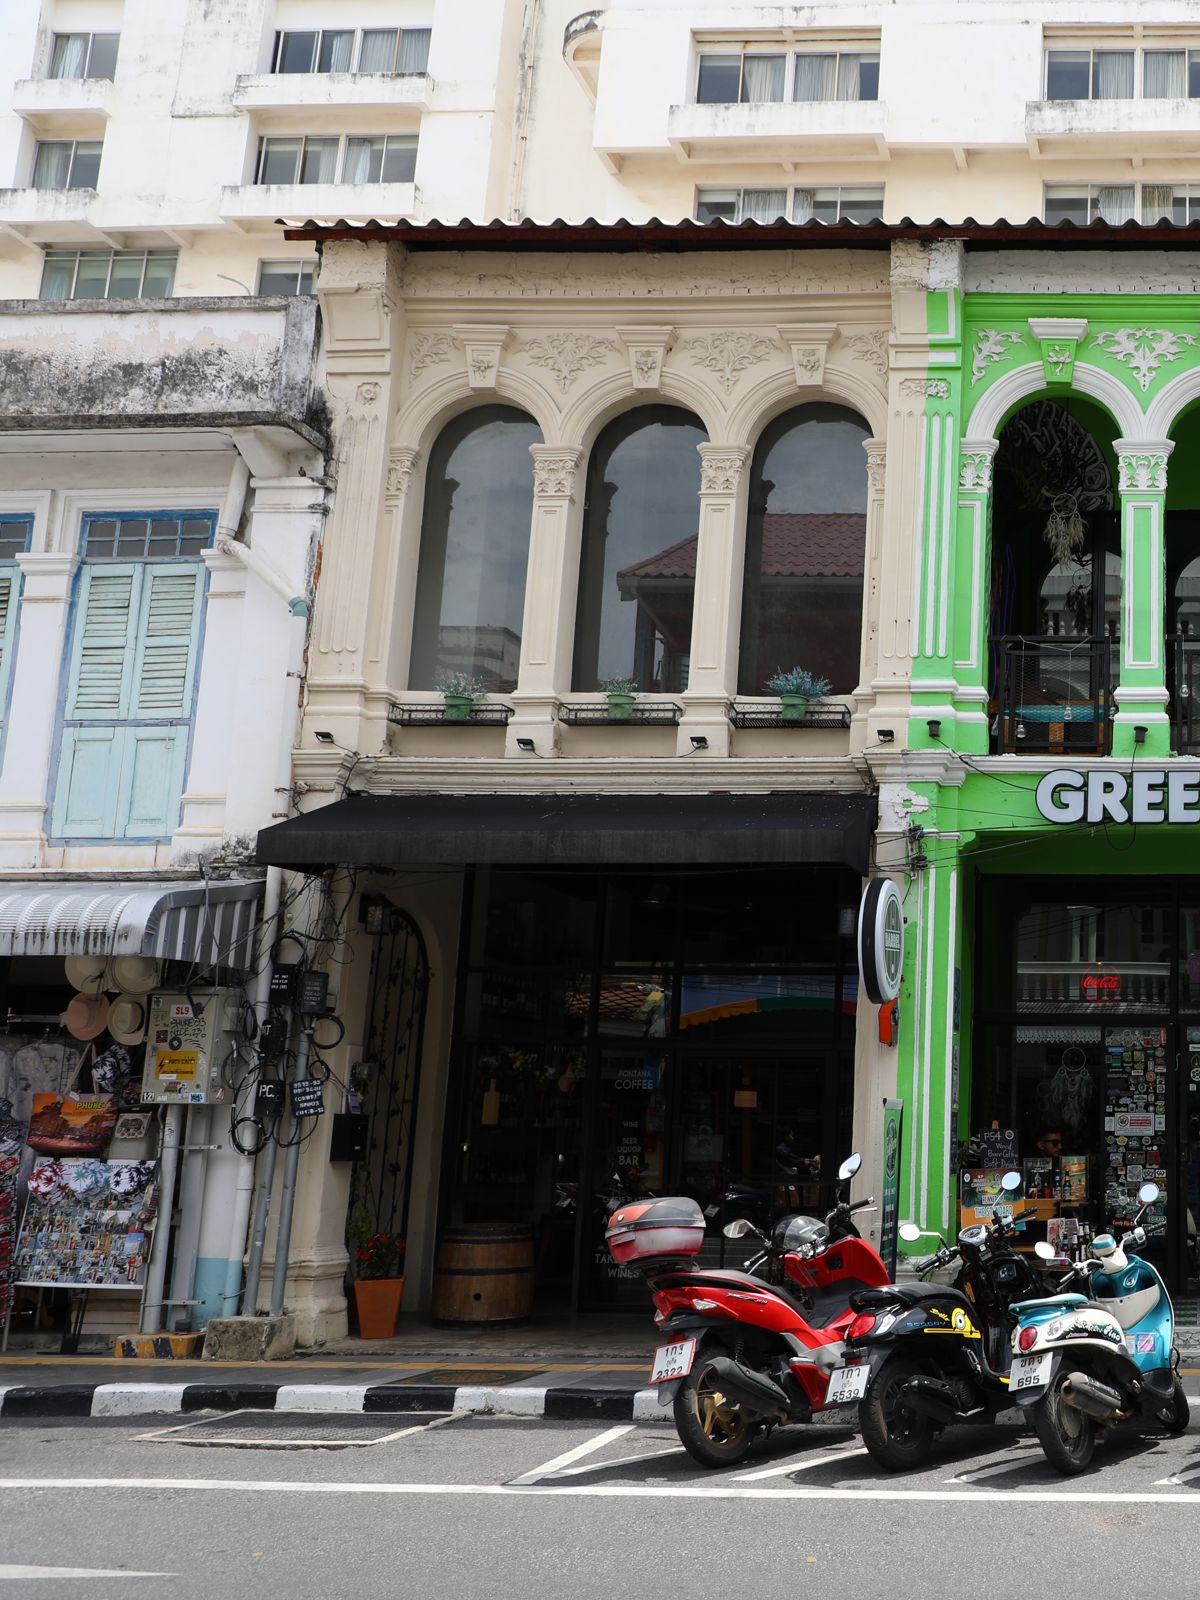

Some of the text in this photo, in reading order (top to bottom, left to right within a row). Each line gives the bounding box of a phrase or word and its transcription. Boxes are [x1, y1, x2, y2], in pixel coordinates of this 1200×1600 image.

[175, 1006, 190, 1015] SL9
[614, 1080, 653, 1090] COFFEE
[619, 1155, 639, 1166] BAR
[608, 1268, 640, 1278] WINES
[1017, 1375, 1040, 1388] 695
[832, 1389, 859, 1402] 5539
